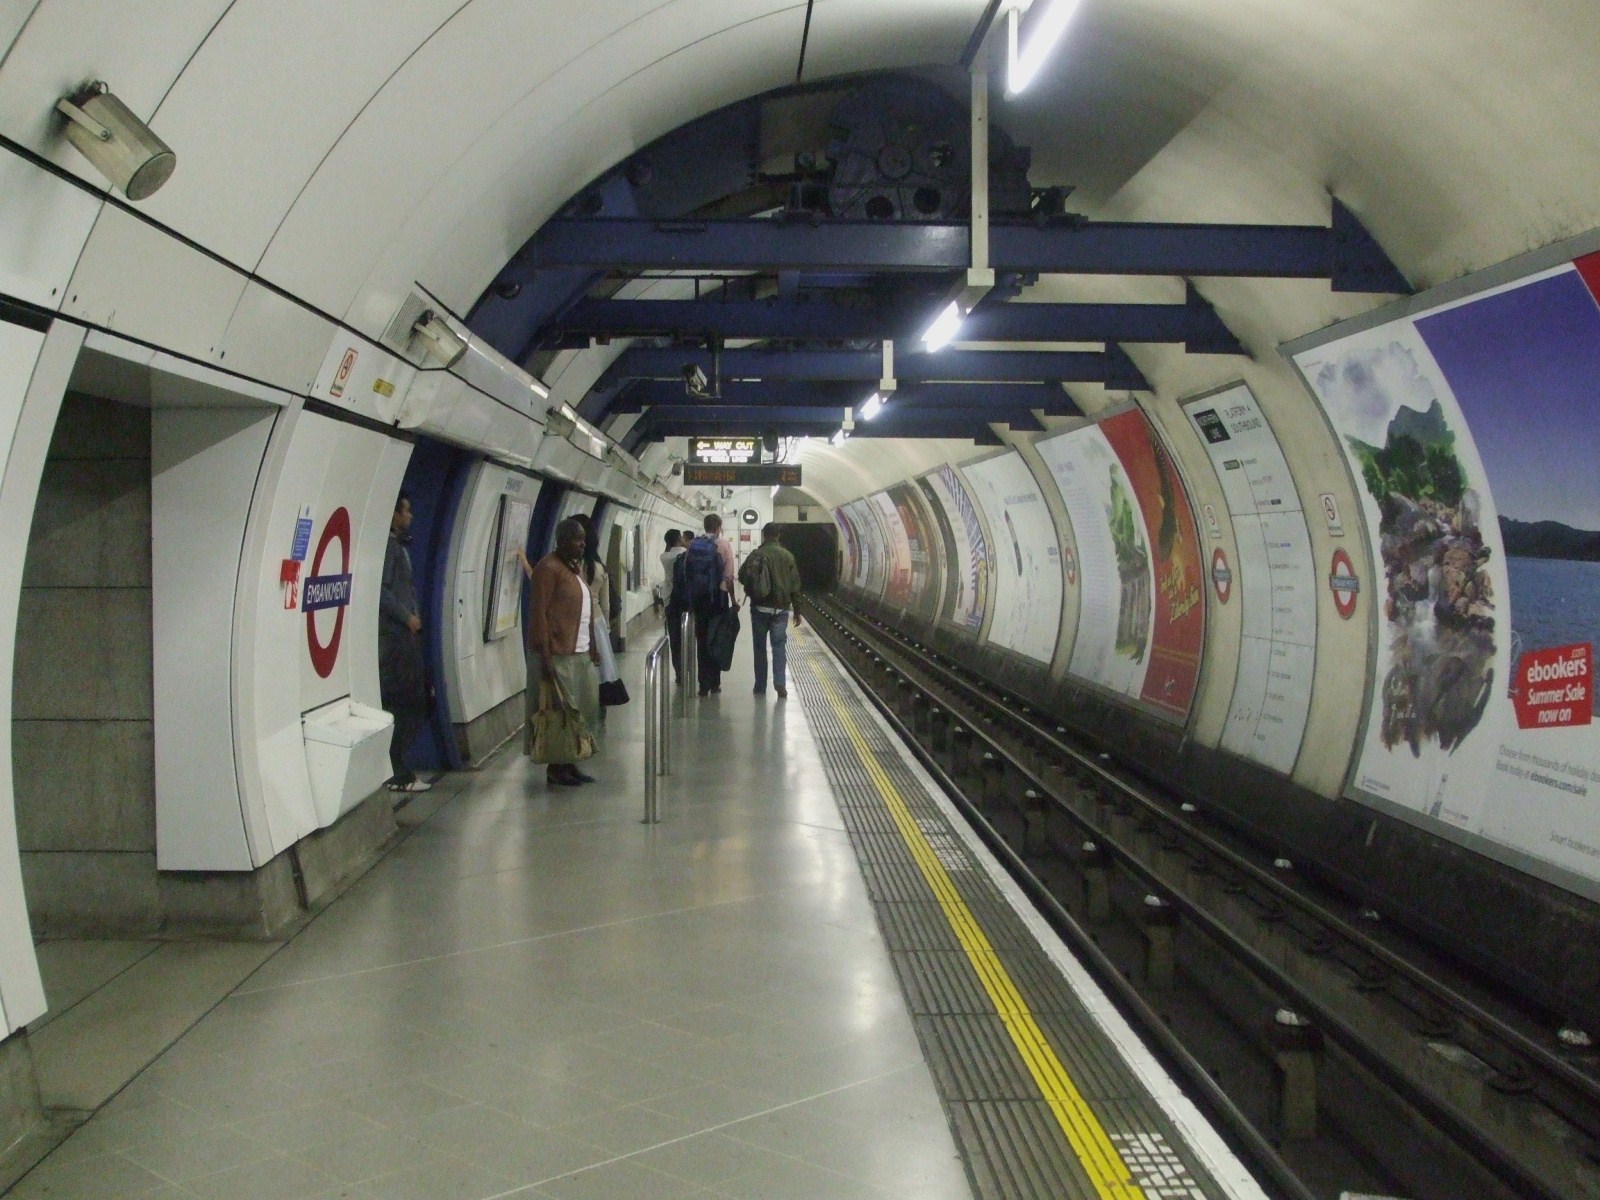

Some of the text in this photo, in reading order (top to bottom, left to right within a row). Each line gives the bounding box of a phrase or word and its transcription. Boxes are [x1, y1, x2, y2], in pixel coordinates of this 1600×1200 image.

[713, 441, 754, 450] WAY OUT
[306, 581, 348, 604] EMBANKMENT
[1527, 656, 1587, 683] ebookers
[1527, 682, 1586, 705] Summer Sale
[1537, 708, 1572, 723] now on
